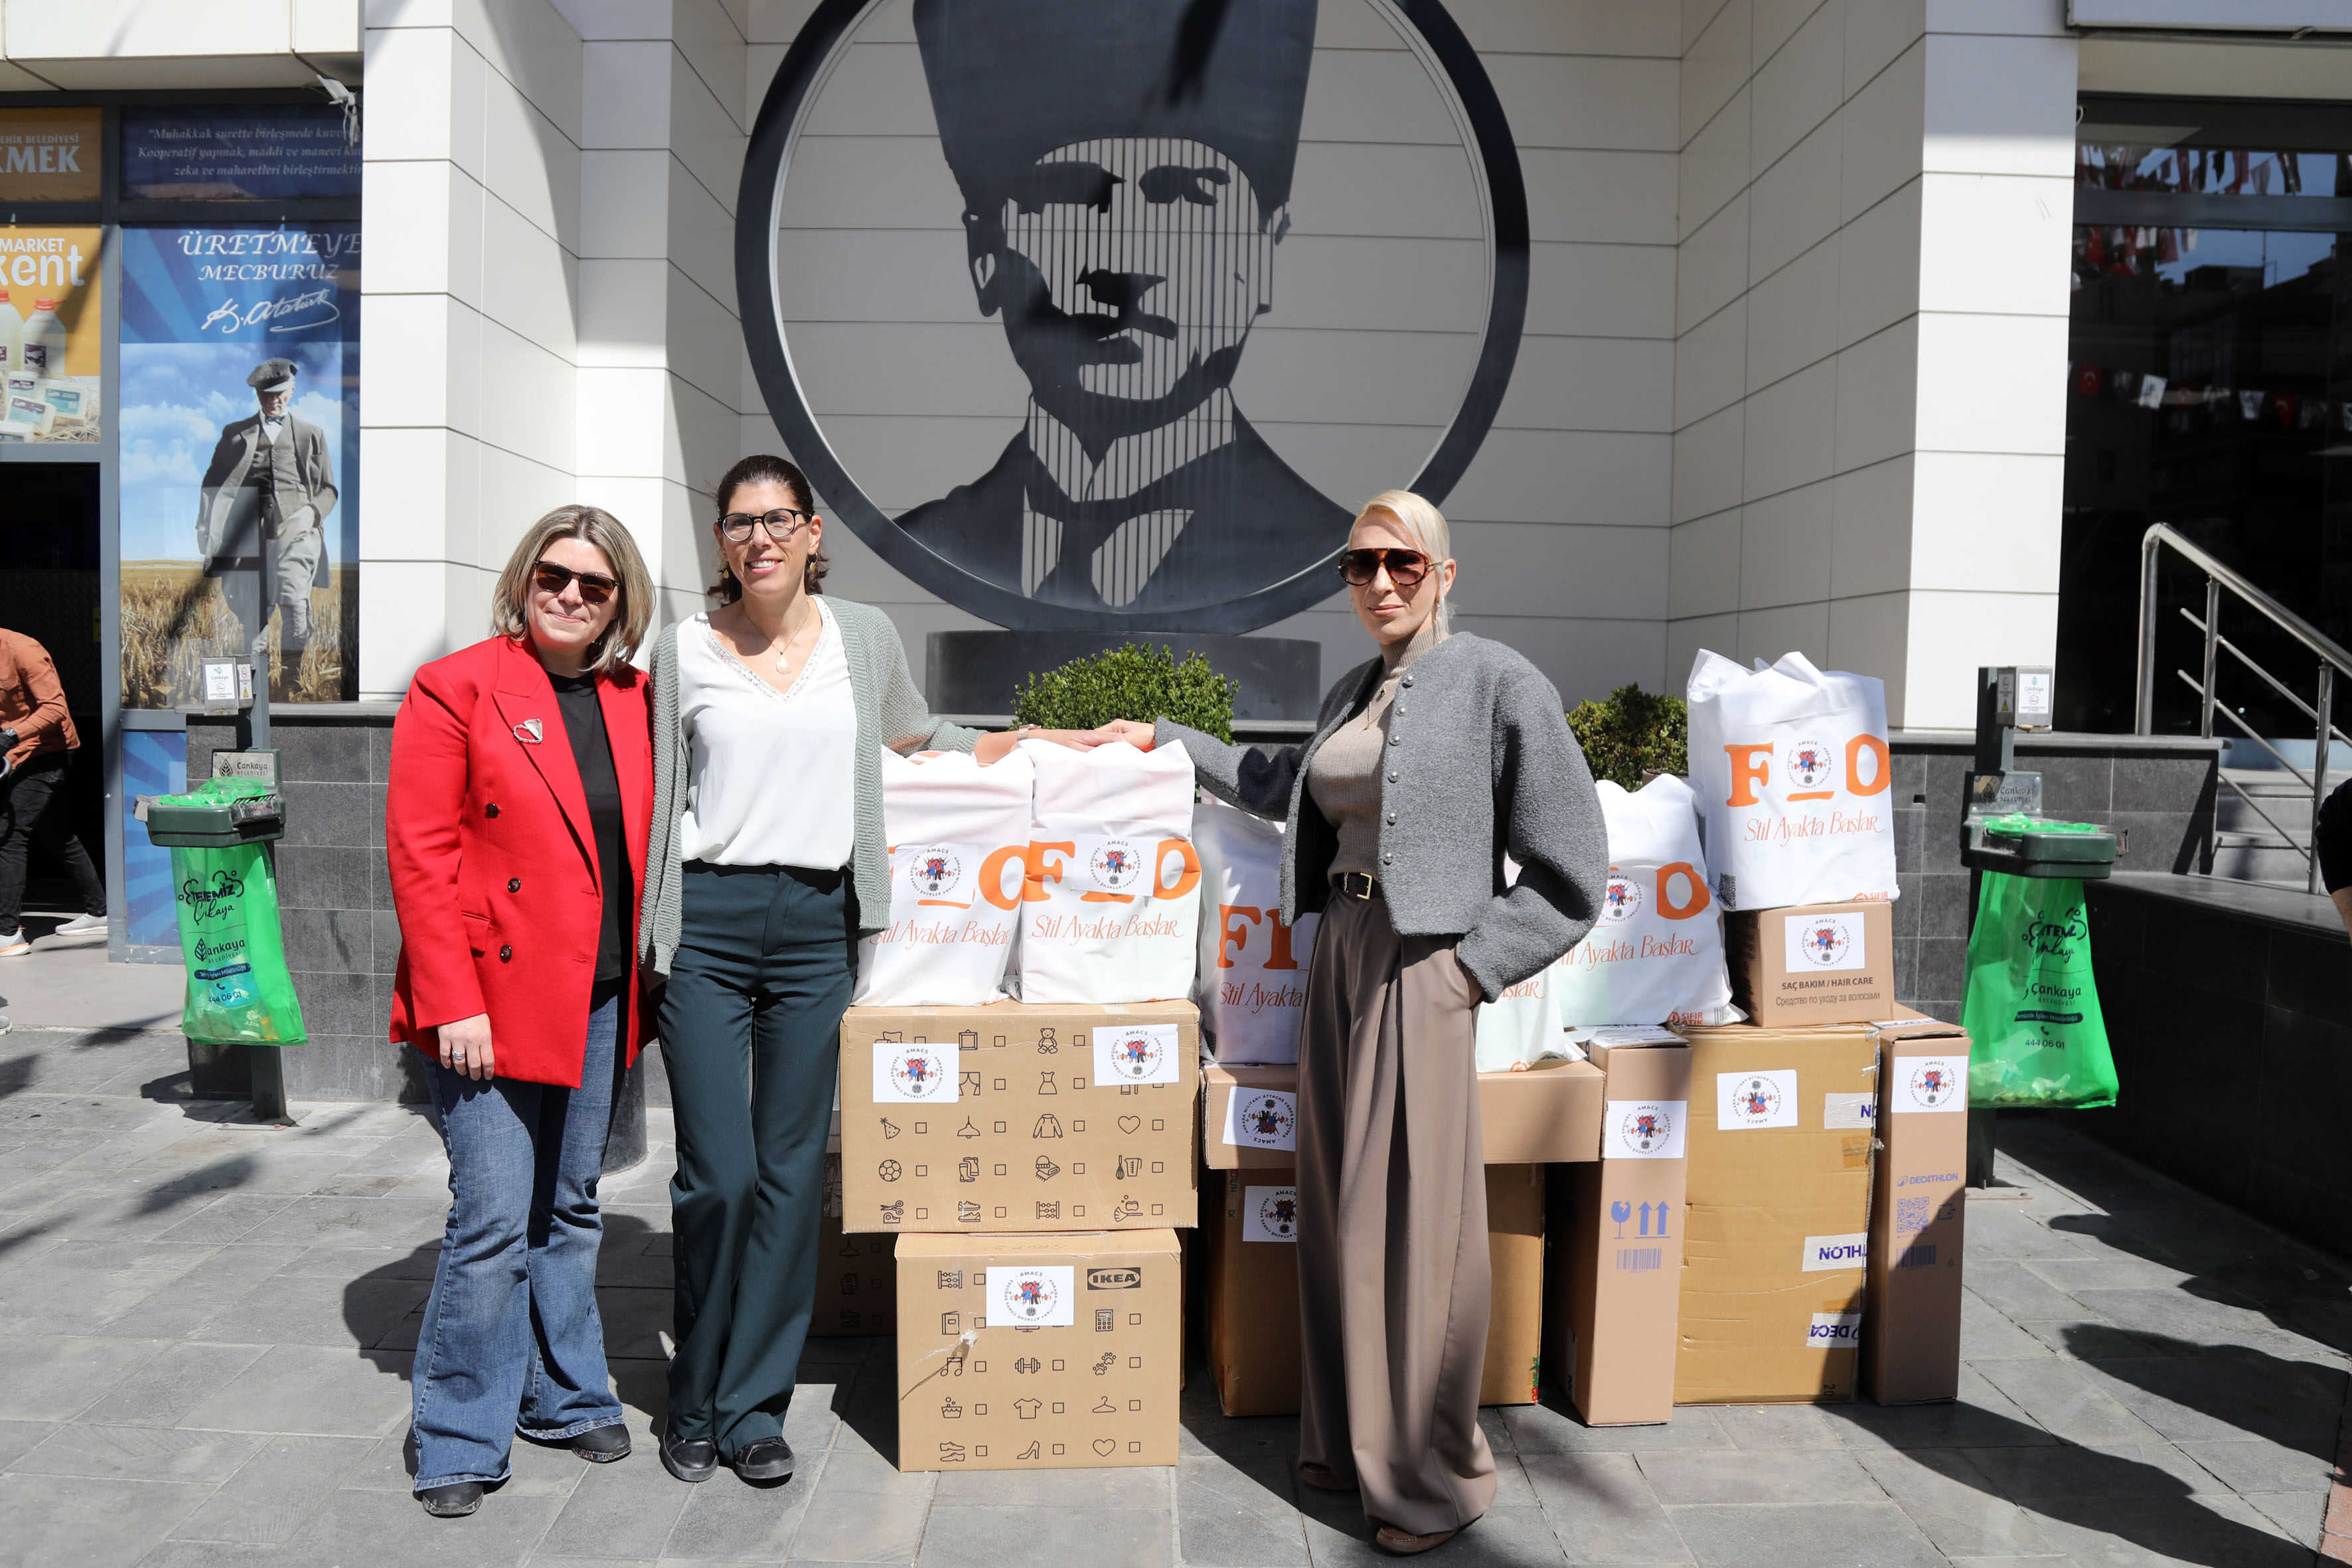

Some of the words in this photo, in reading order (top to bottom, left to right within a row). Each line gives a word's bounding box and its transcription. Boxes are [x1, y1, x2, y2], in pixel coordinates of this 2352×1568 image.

[25, 133, 79, 144] BELEDİYESİ
[178, 231, 362, 258] ÜRETMEYE
[198, 264, 339, 281] MECBURUZ
[1724, 734, 1891, 807] FO
[1745, 817, 1772, 842] Stil
[1773, 815, 1825, 848] Ayakta
[1022, 838, 1202, 904] FO
[899, 919, 958, 950] Ayakta
[1032, 915, 1063, 938] Stil
[1063, 915, 1122, 947] Ayakta
[1579, 938, 1635, 971] Ayakta
[1218, 981, 1245, 1006] Stil
[1246, 982, 1303, 1014] Ayakta
[1782, 981, 1798, 991] SAÇ
[1799, 979, 1826, 989] BAKIM
[1831, 978, 1850, 986] HAIR
[2031, 982, 2081, 1000] Çankaya
[1776, 996, 1808, 1007] Средство
[1819, 994, 1838, 1005] уходу
[1848, 992, 1880, 1001] волосами
[1910, 1173, 1958, 1184] DECATHLON
[1093, 1273, 1137, 1284] IKEA
